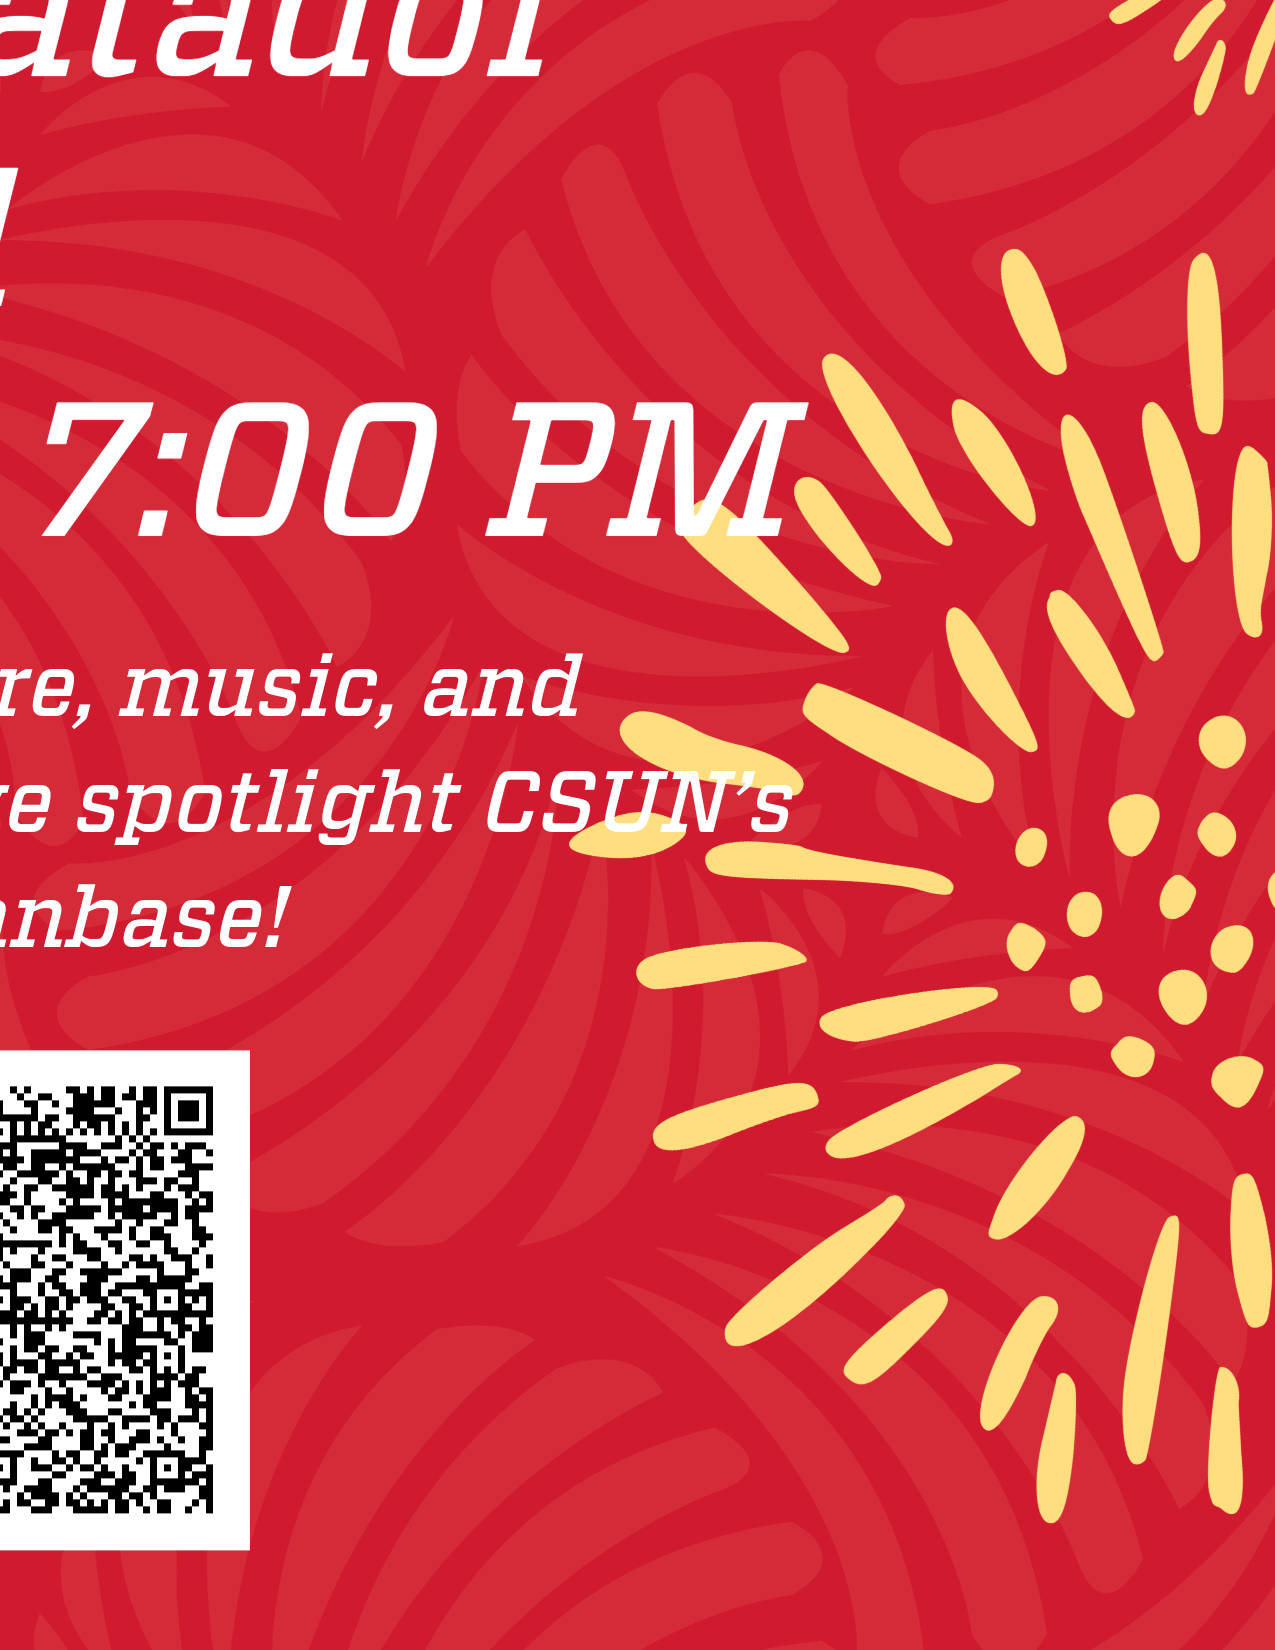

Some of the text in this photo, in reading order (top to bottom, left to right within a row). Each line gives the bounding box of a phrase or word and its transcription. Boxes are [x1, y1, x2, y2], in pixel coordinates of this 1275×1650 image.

[42, 402, 436, 536] 7:00
[485, 403, 808, 536] PM
[119, 653, 392, 729] music,
[424, 654, 583, 716] and
[77, 769, 461, 845] spotlight
[488, 771, 794, 832] CSUN’s
